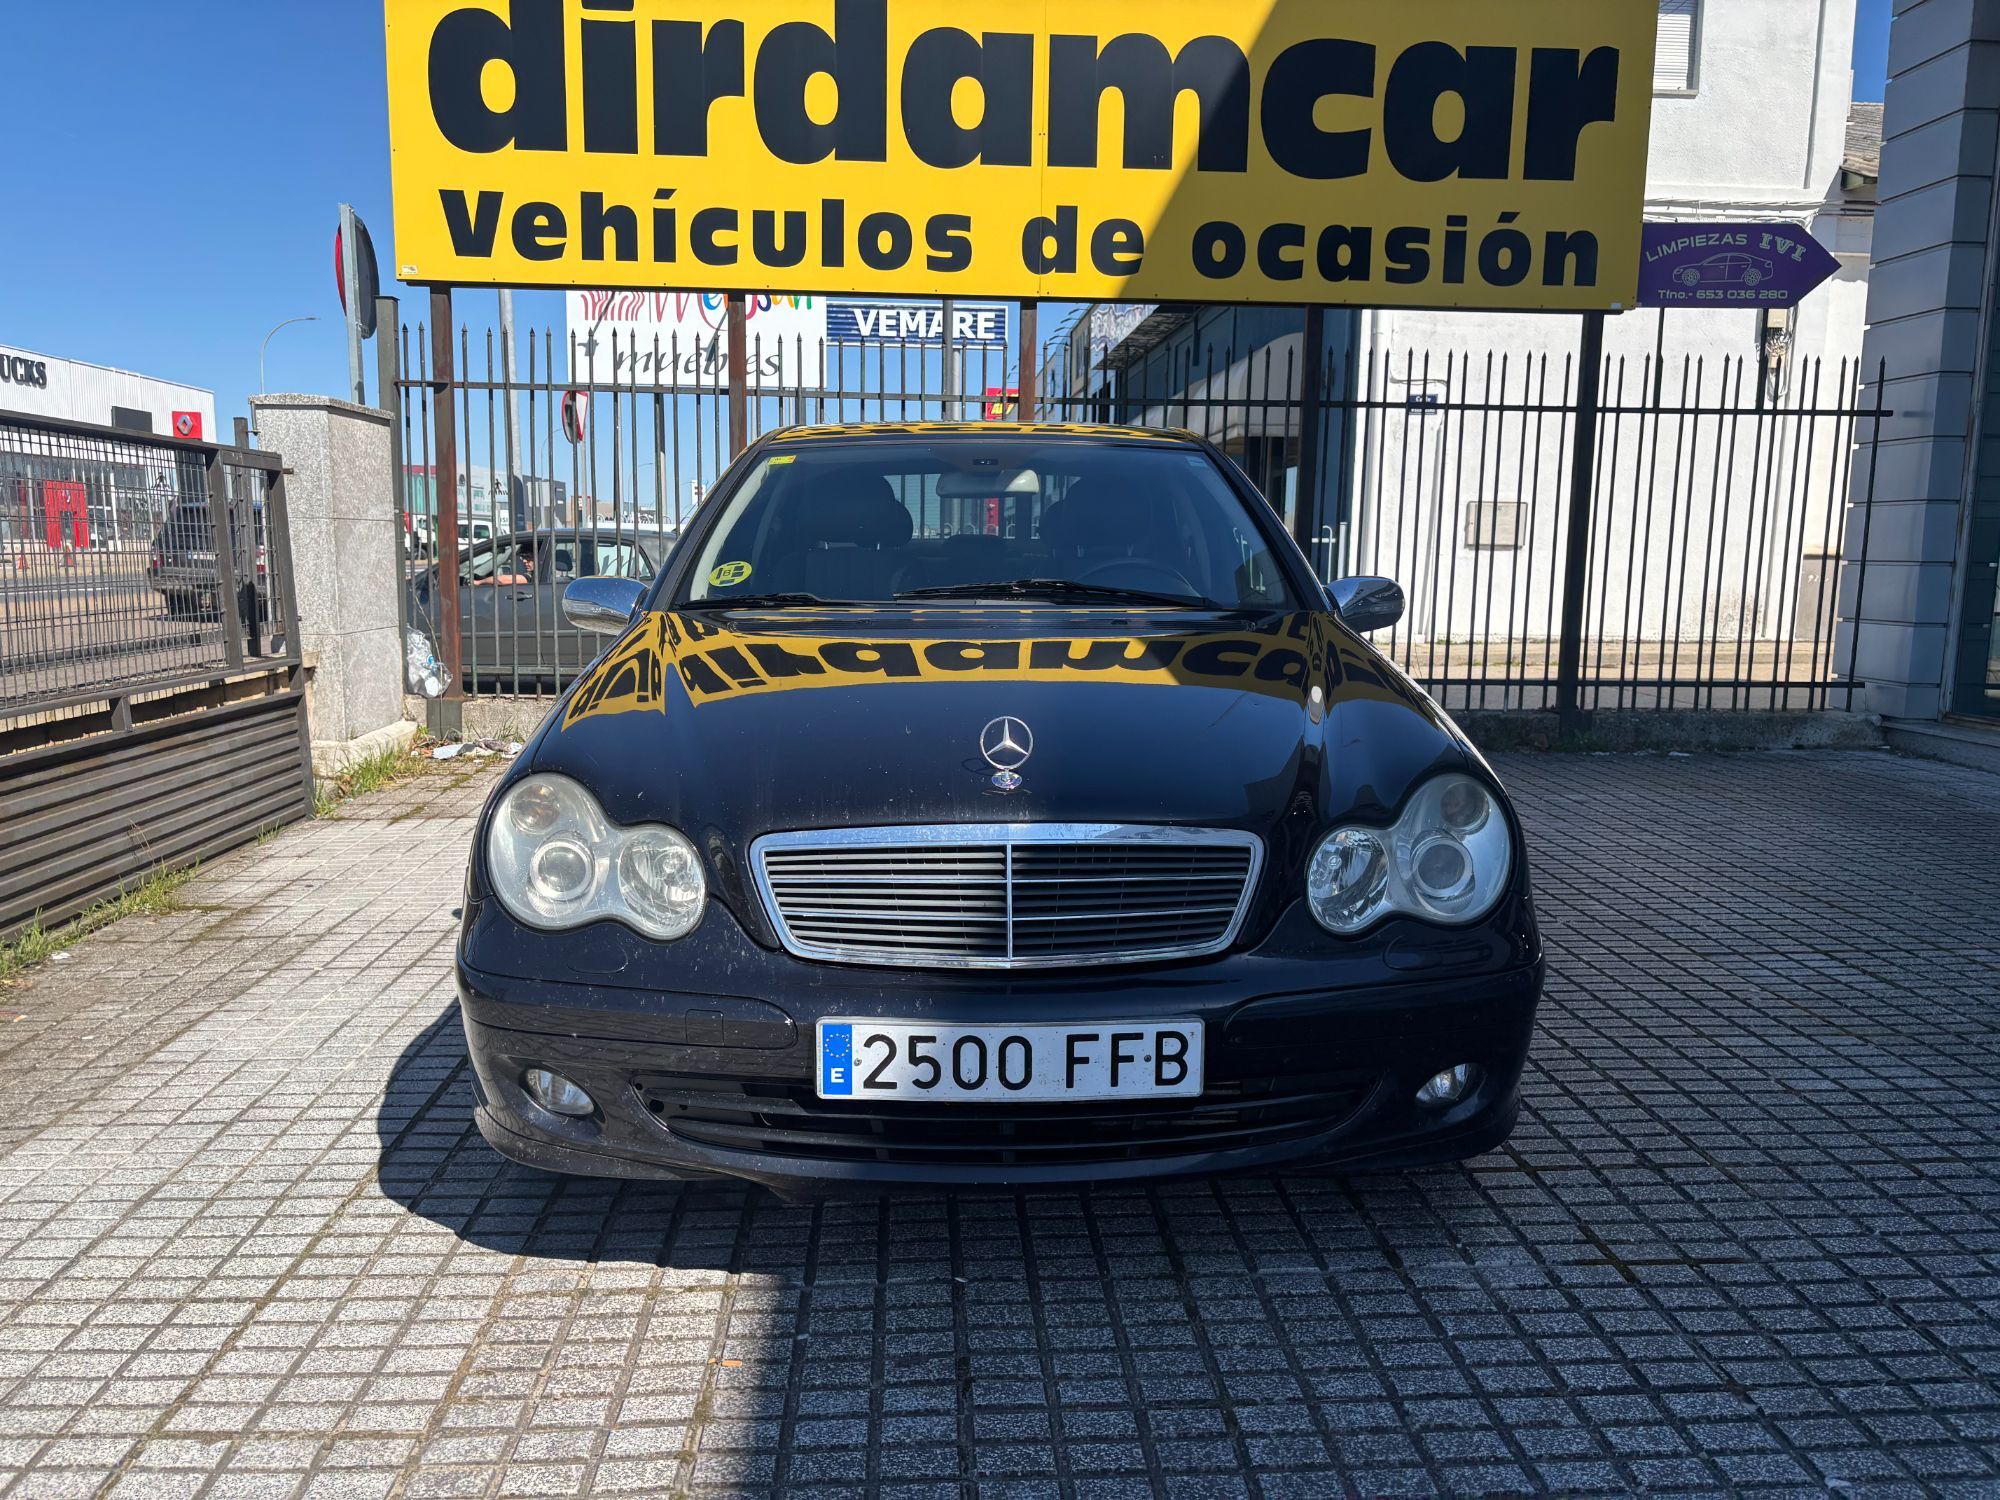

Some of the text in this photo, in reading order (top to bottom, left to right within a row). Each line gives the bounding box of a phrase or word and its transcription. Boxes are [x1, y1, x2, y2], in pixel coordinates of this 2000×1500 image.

[428, 0, 1621, 183] dirdamcar
[438, 188, 1600, 288] Vehículos de ocasión
[1645, 232, 1807, 262] LIMPIEZAS IVI
[1696, 289, 1724, 300] 653
[1727, 289, 1756, 300] 036
[1758, 289, 1788, 300] 280
[830, 1067, 845, 1083] E
[863, 1030, 1190, 1091] 2500 FFB
